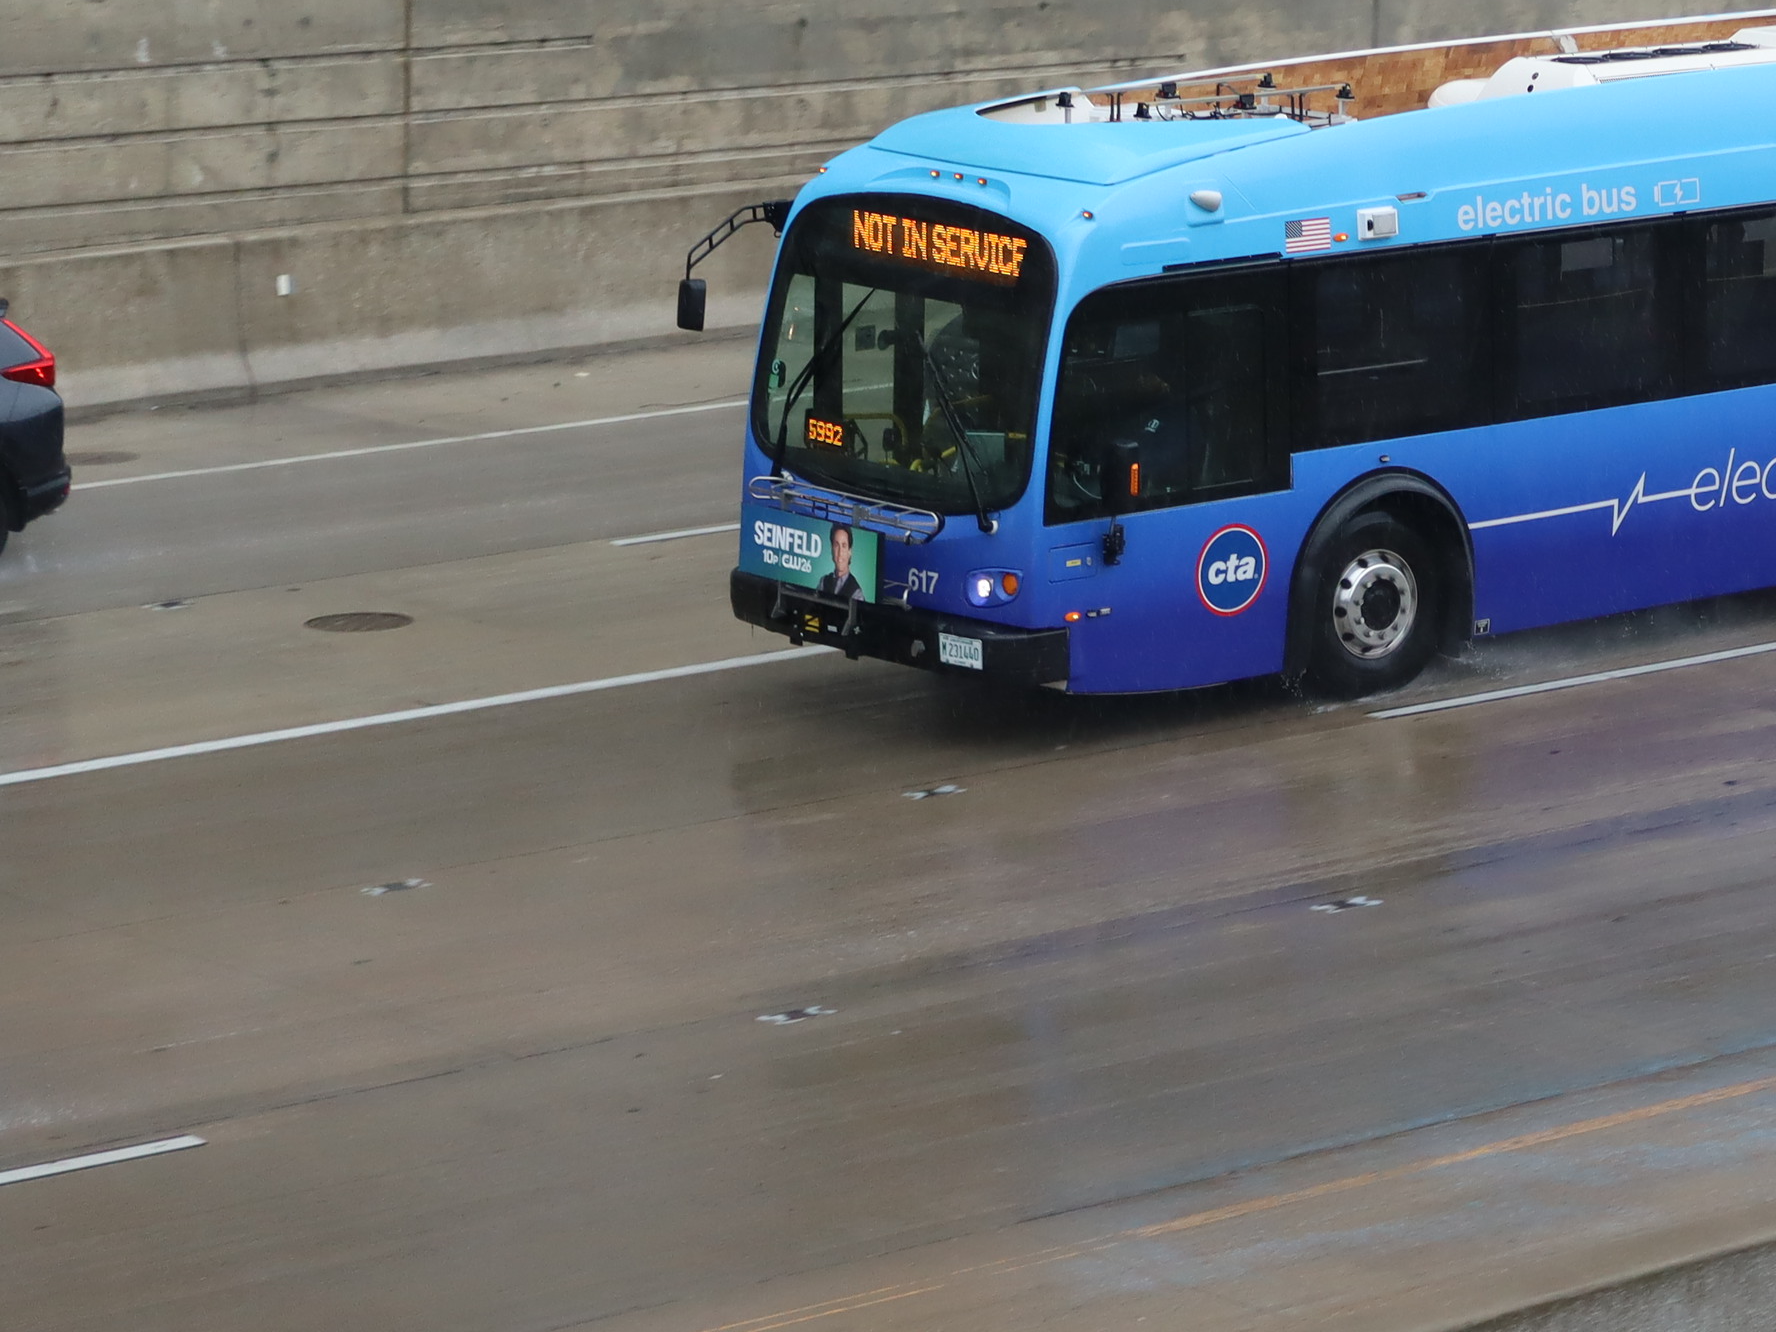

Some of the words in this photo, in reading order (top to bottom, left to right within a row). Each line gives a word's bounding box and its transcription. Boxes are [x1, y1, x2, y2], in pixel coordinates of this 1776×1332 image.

[1457, 187, 1572, 231] electric
[1581, 183, 1637, 216] bus
[853, 209, 897, 255] NOT
[901, 217, 928, 261] IN
[931, 223, 1028, 278] SERVICE
[808, 418, 843, 447] 5992
[753, 519, 822, 559] SEINFELD
[908, 567, 940, 596] 617
[1207, 553, 1257, 586] cta
